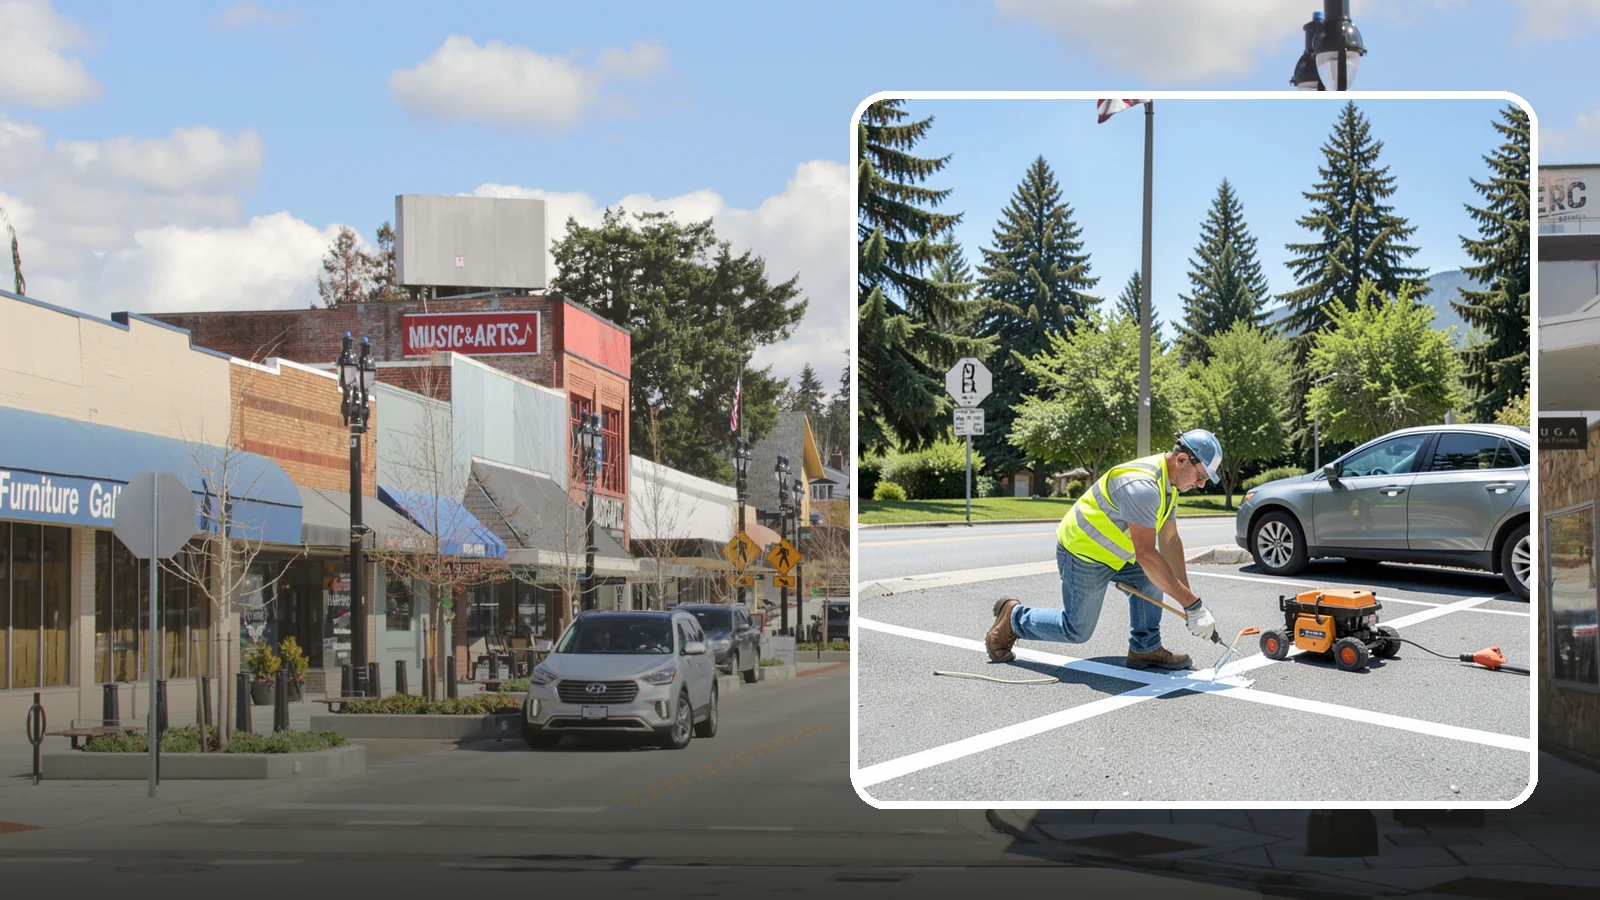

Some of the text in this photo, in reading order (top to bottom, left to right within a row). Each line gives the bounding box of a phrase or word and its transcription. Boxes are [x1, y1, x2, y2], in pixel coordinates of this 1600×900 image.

[1540, 427, 1577, 436] UGA
[0, 471, 79, 515] Furniture
[454, 563, 479, 574] SUSHI
